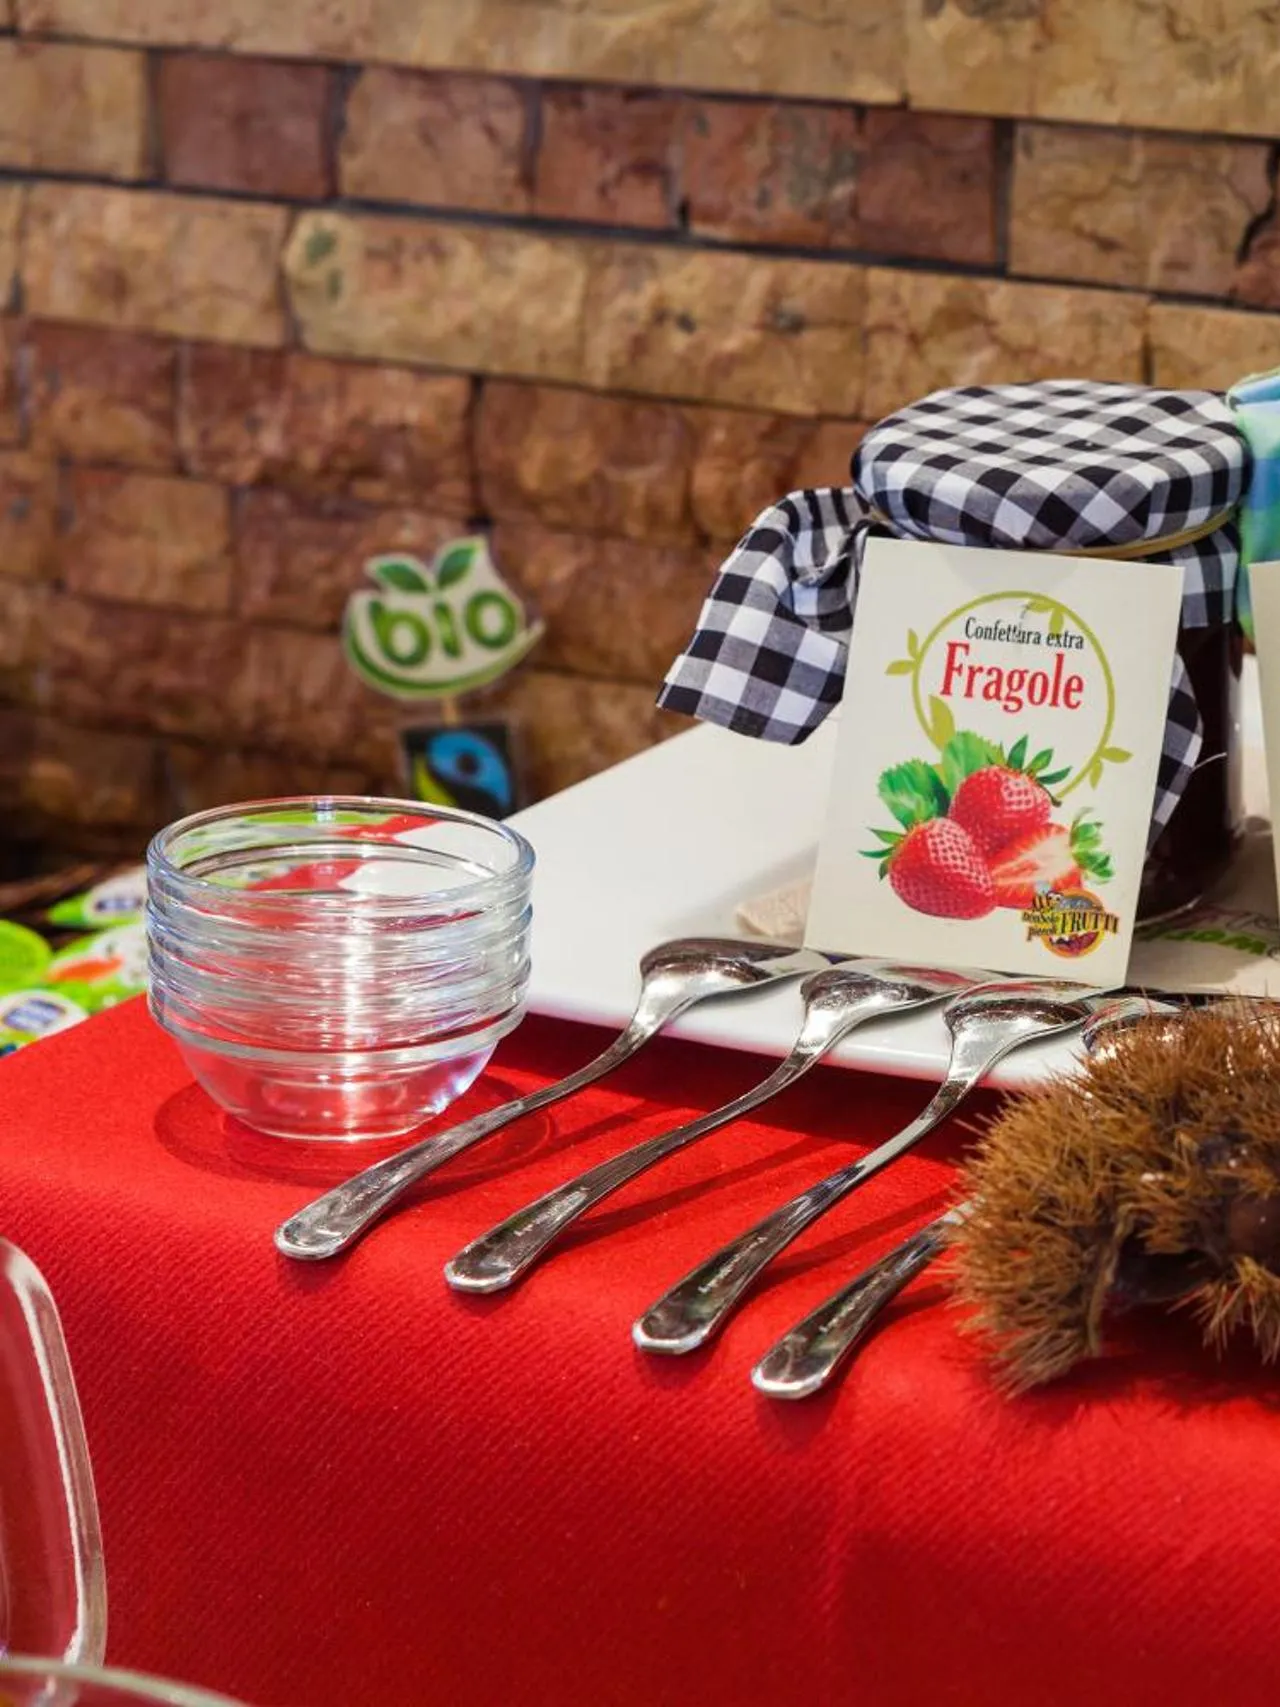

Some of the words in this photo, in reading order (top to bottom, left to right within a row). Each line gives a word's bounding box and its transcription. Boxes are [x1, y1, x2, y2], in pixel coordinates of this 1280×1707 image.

[964, 616, 1042, 645] Confettura
[1046, 629, 1085, 650] extra
[939, 640, 1084, 714] Fragole
[1060, 909, 1120, 935] FRUTTI
